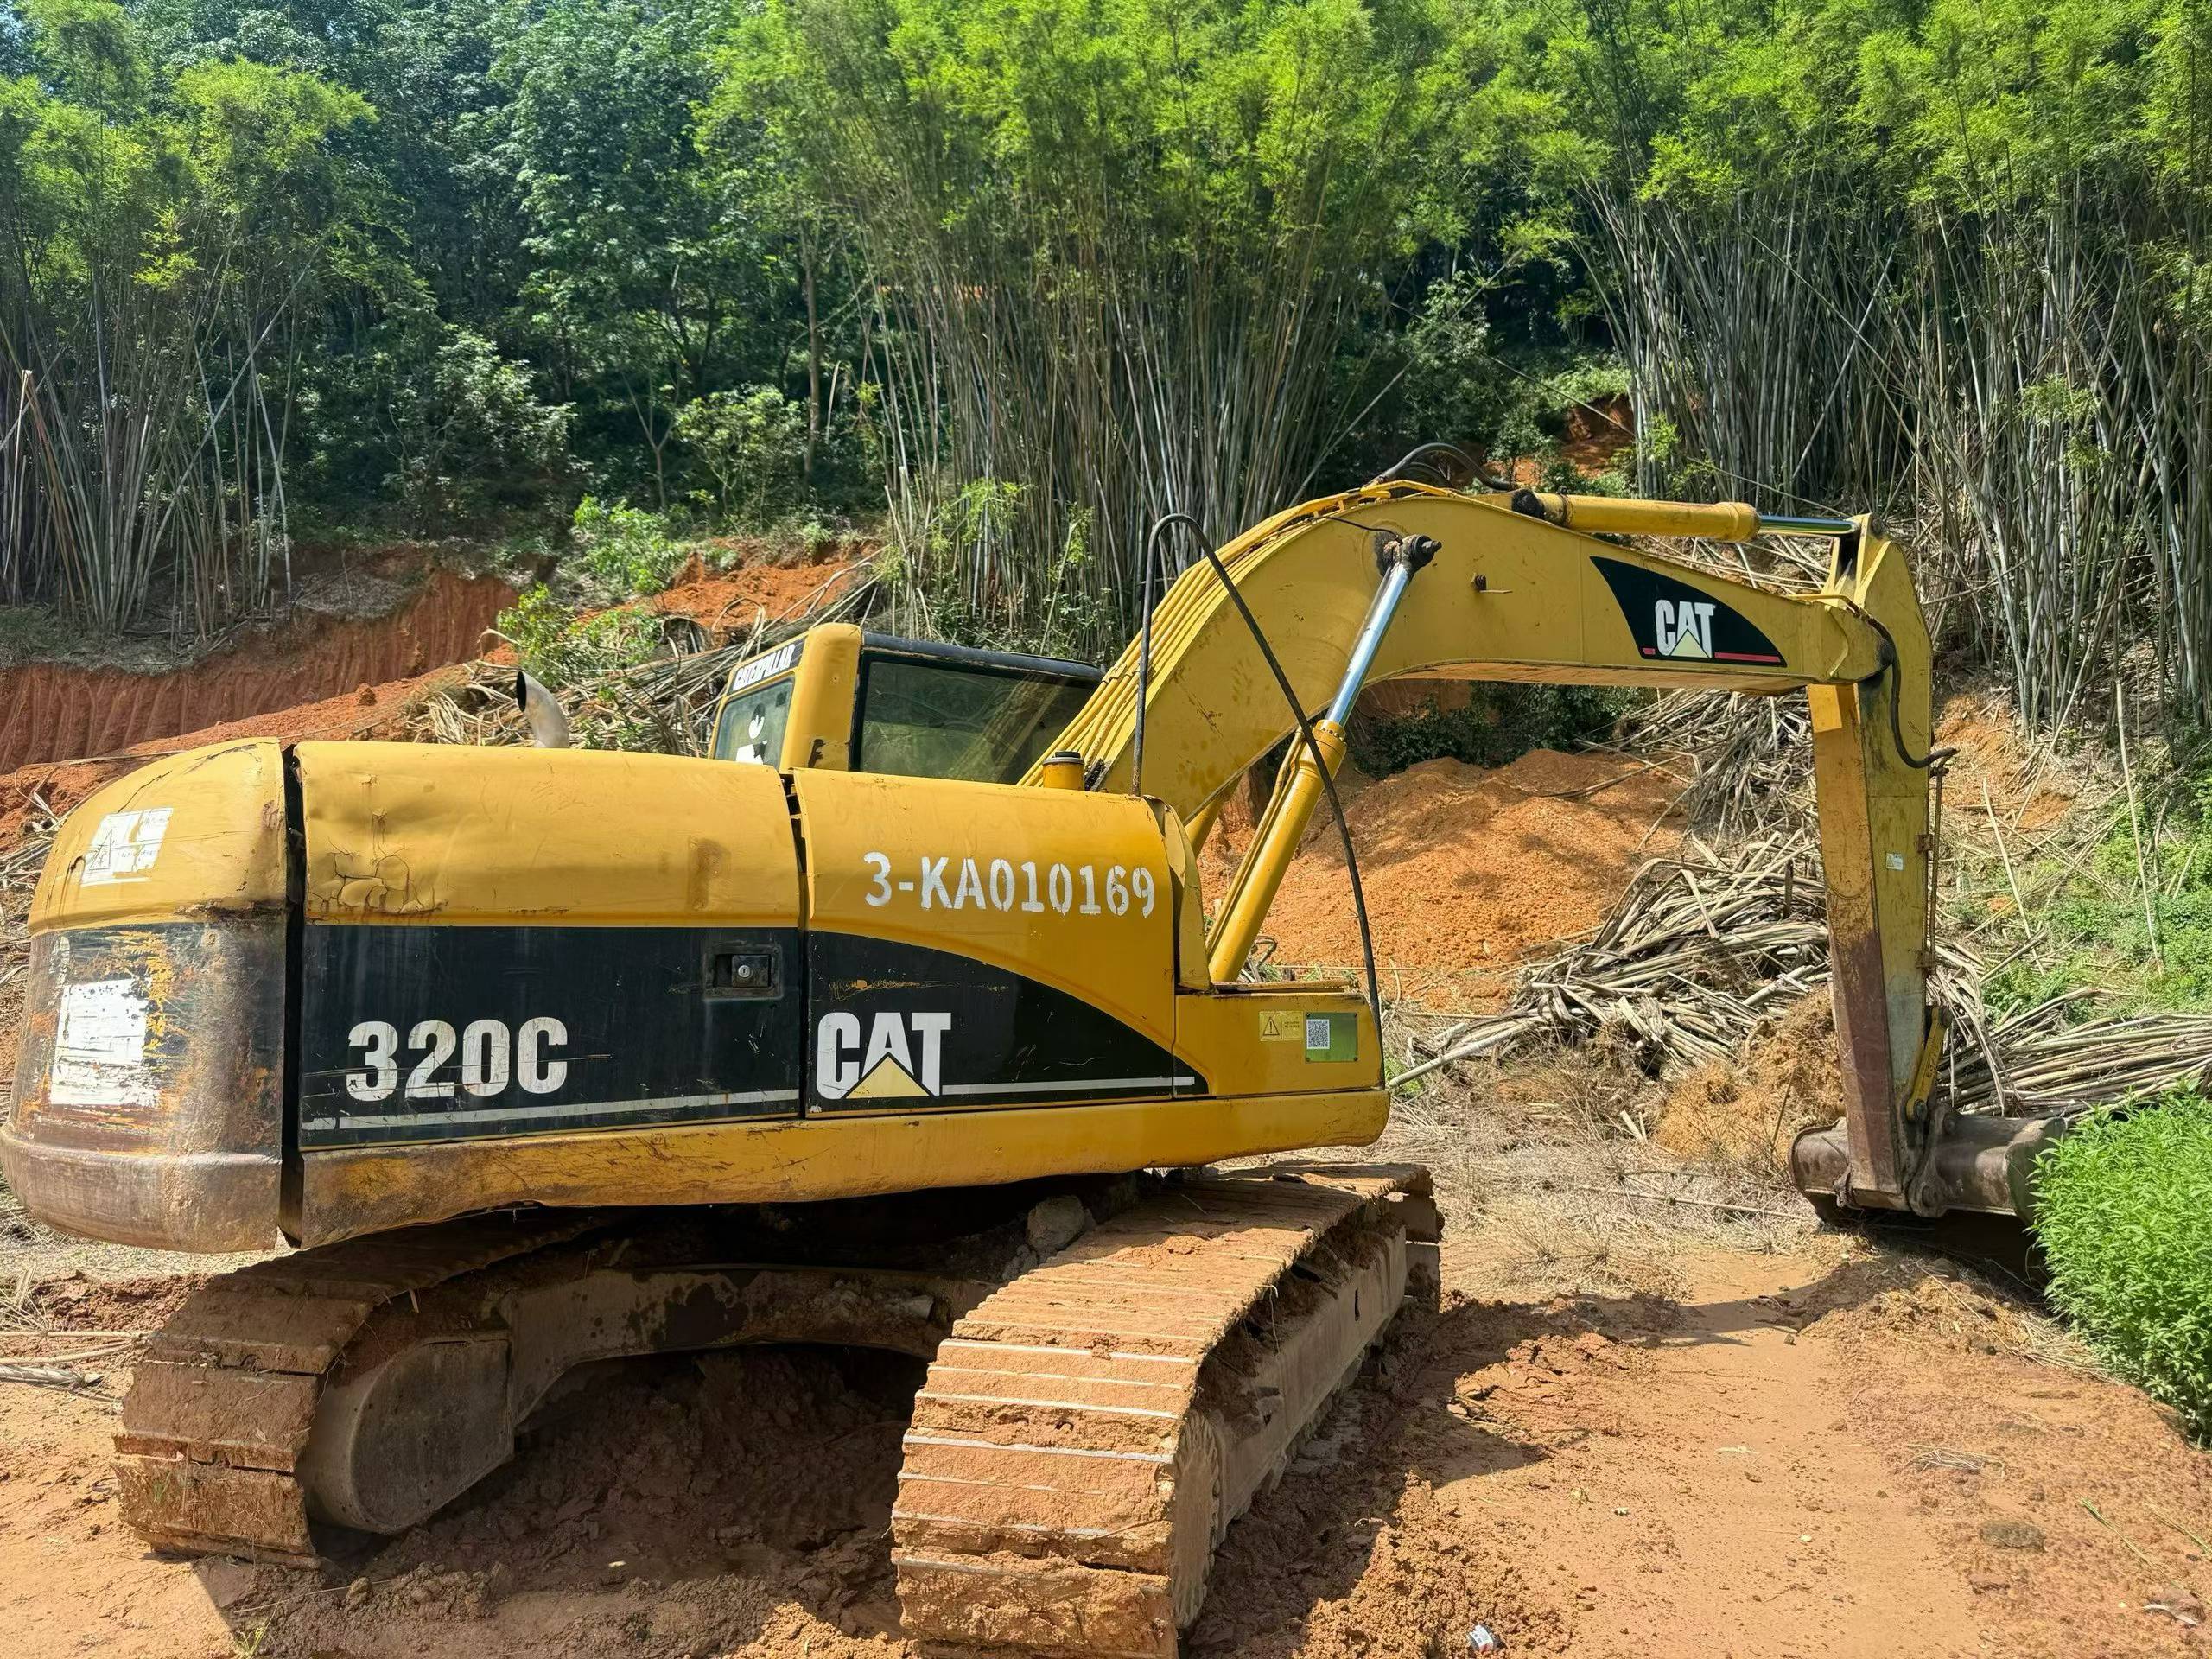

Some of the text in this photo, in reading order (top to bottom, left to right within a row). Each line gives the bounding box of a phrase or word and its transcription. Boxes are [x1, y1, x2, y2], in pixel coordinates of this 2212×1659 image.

[1655, 600, 1714, 658] CAT
[863, 851, 1154, 918] 3-KA010169
[346, 1016, 568, 1102] 320C
[817, 1012, 953, 1100] CAT
